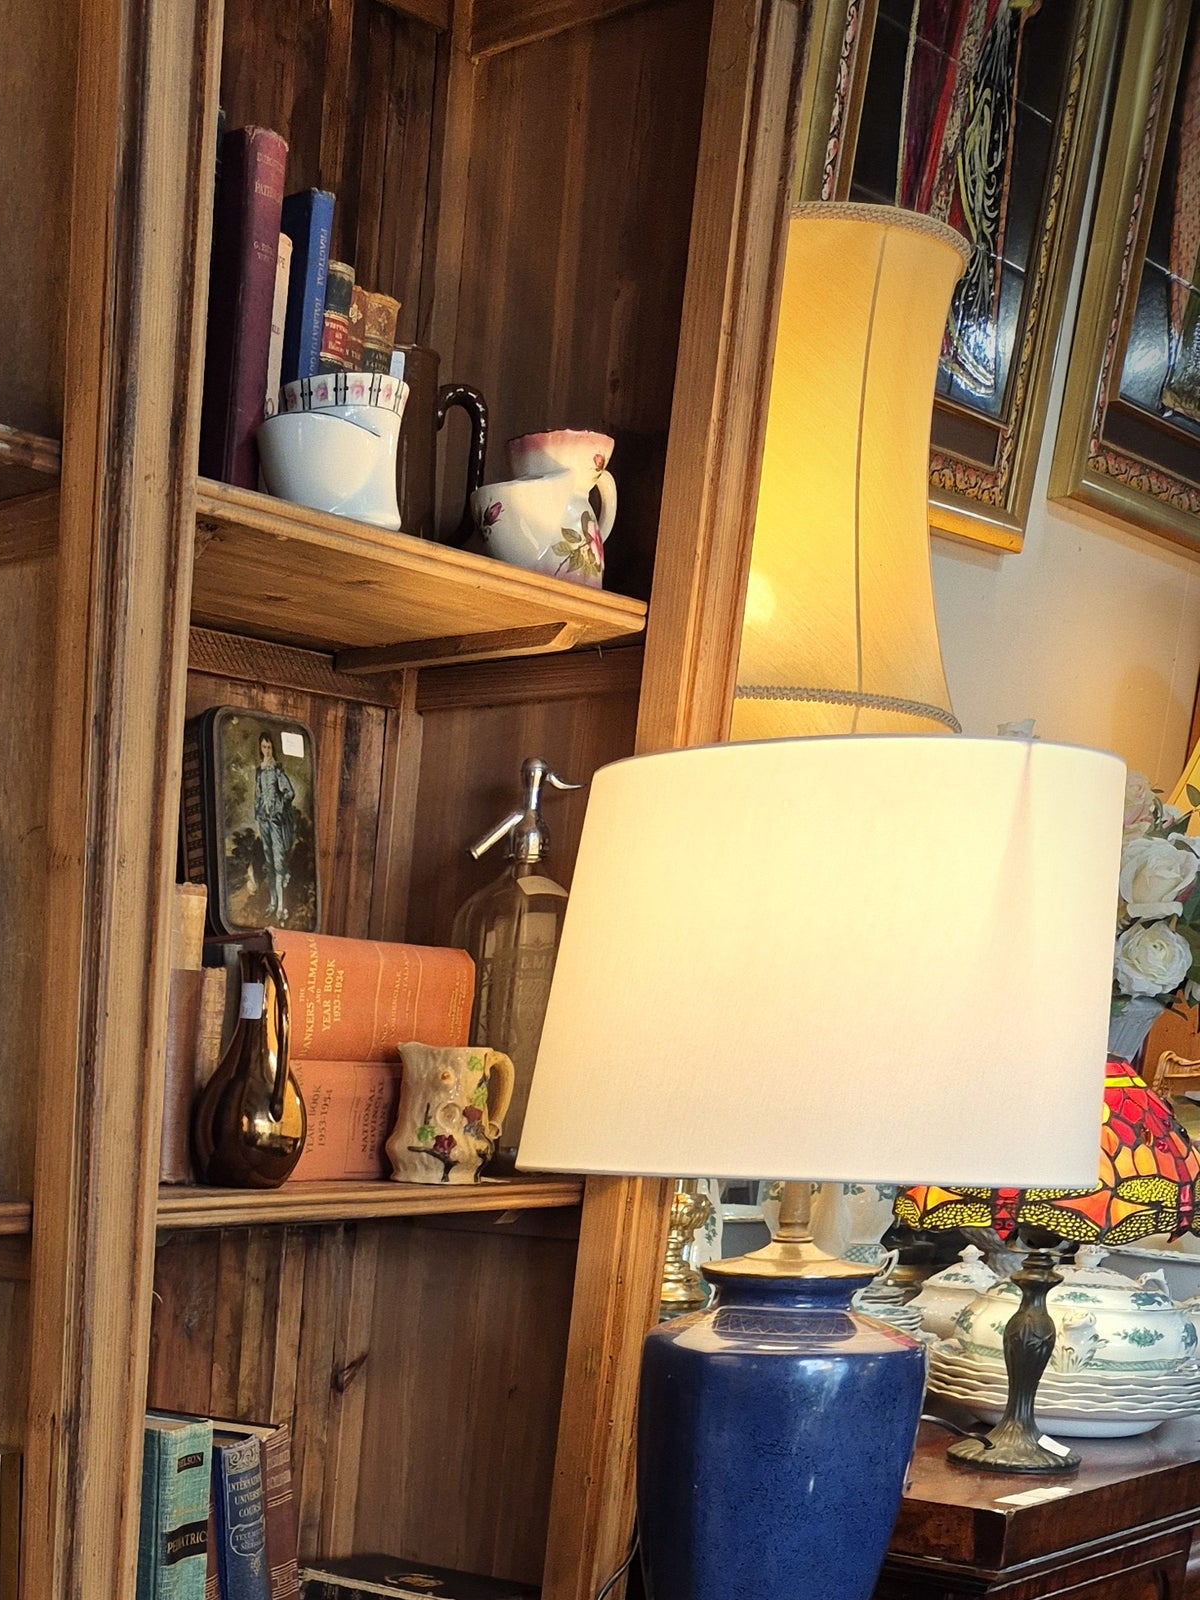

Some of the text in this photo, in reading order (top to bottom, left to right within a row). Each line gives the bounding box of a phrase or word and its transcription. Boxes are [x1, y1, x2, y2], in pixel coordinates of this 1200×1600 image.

[322, 958, 337, 1033] YEAR BOOK
[361, 1084, 377, 1154] NATIONAL
[368, 1081, 385, 1160] PROVINCIAL
